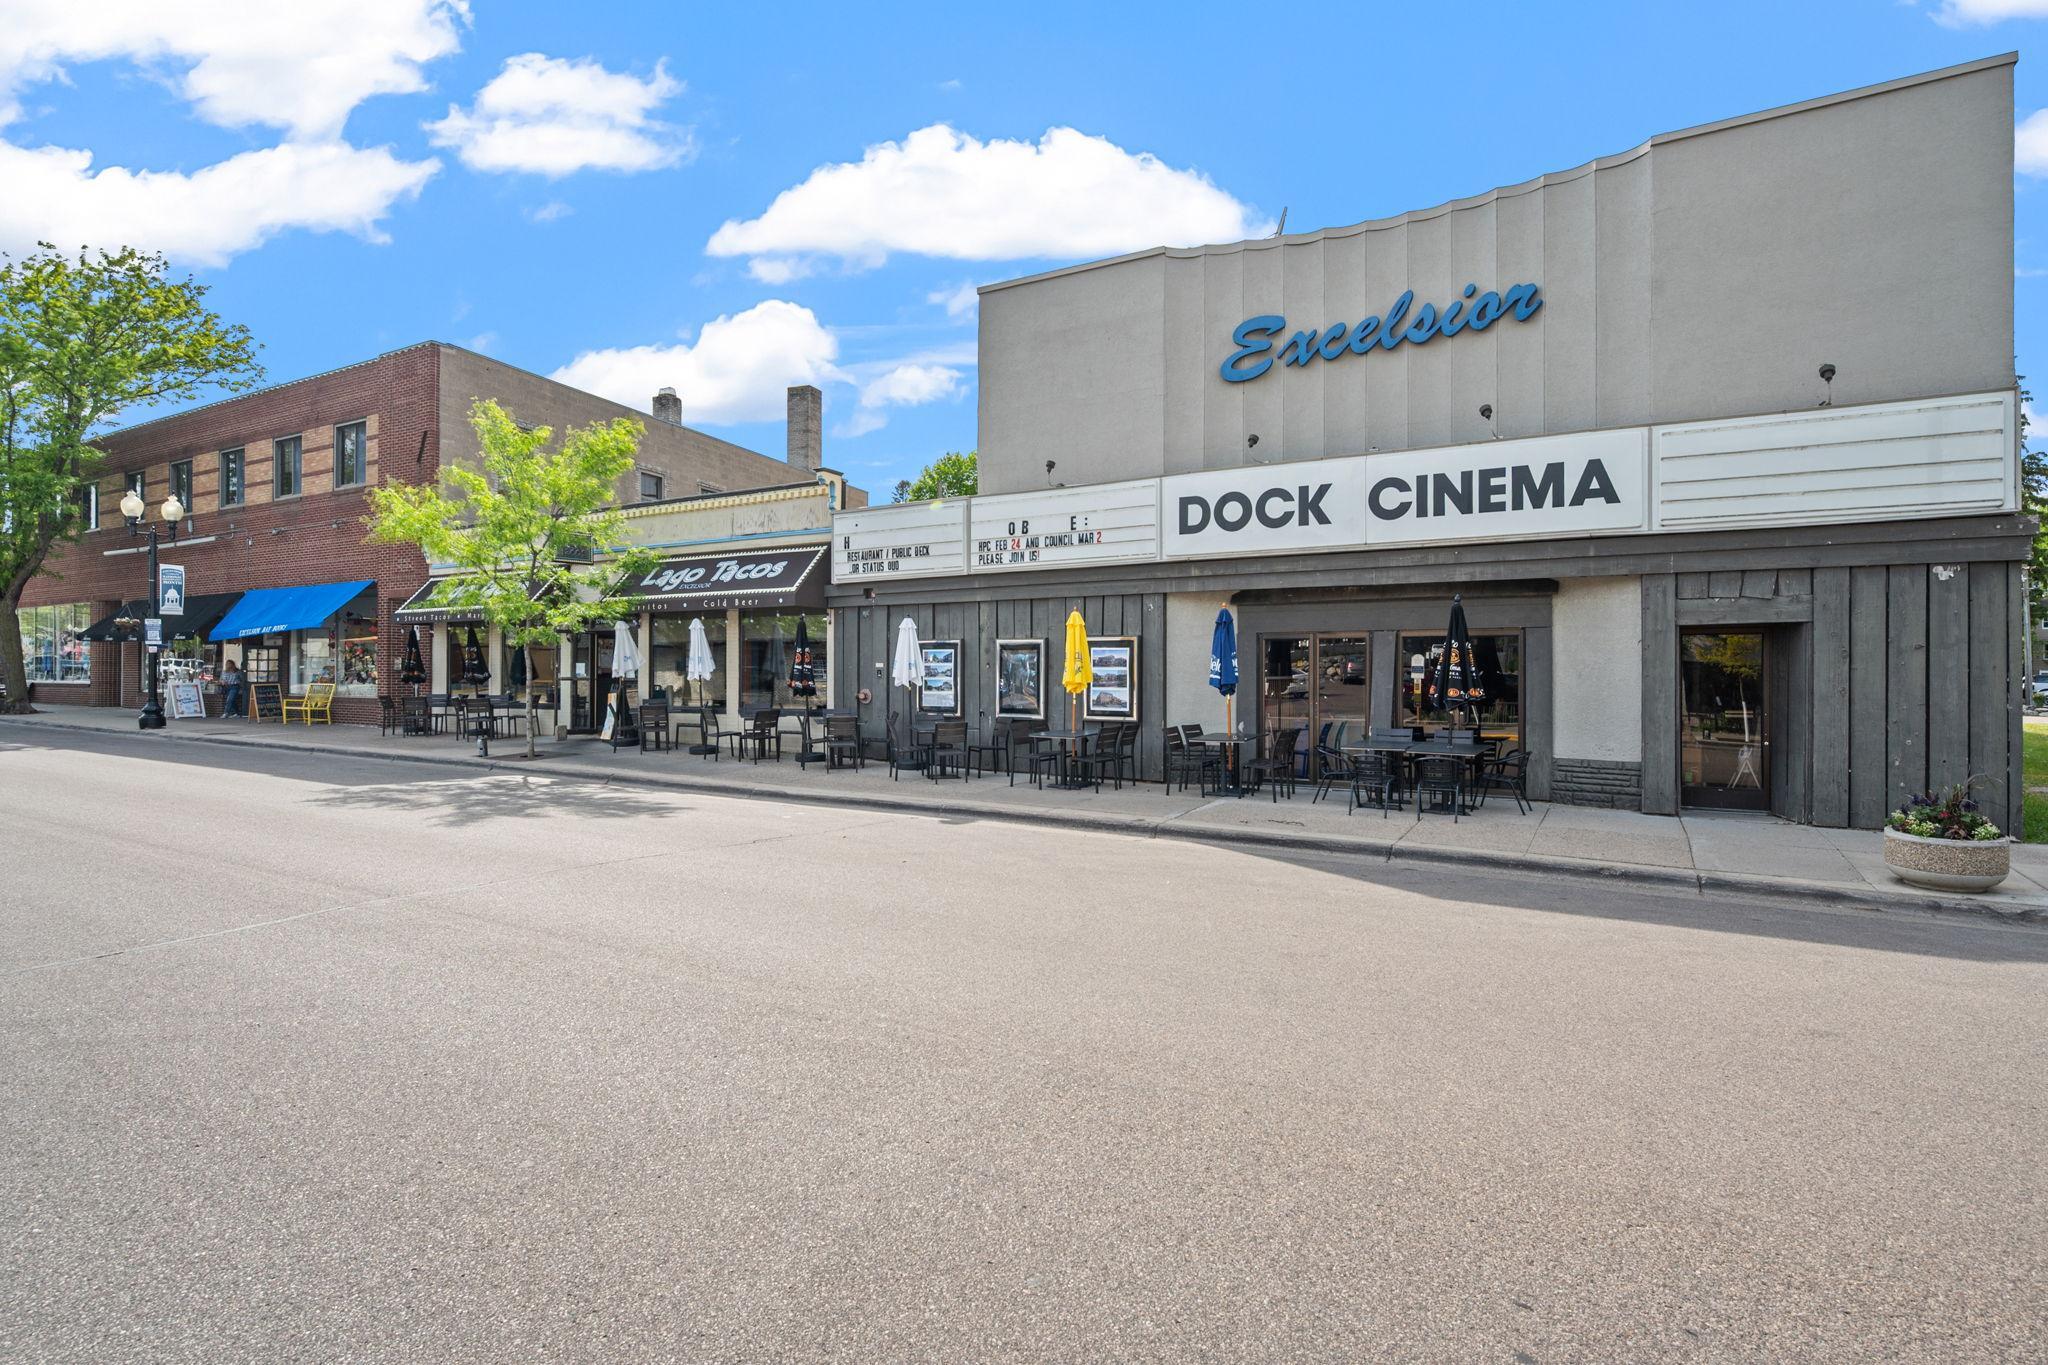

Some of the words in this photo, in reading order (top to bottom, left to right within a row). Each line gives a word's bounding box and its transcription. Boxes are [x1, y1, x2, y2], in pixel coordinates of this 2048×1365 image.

[1219, 282, 1544, 382] Excelsior
[1178, 482, 1333, 535] DOCK
[1367, 458, 1621, 520] CINEMA
[844, 536, 850, 549] H
[978, 540, 991, 552] HPC
[995, 539, 1008, 551] FEB
[1011, 538, 1021, 550] 24
[1025, 536, 1040, 549] AND
[1044, 534, 1074, 548] COUNCIL
[1078, 532, 1094, 544] MAR
[1096, 531, 1102, 543] 2
[846, 549, 884, 562] RESTAURANT
[891, 547, 912, 559] PUBLIC
[914, 545, 930, 557] DECK
[978, 553, 1004, 565] PLEASE
[1008, 551, 1025, 563] JOIN
[1029, 550, 1040, 561] US!
[640, 566, 706, 592] Lago
[710, 560, 788, 583] Tacos
[862, 562, 885, 573] STATUS
[703, 598, 727, 608] Cold
[734, 598, 759, 607] Beer
